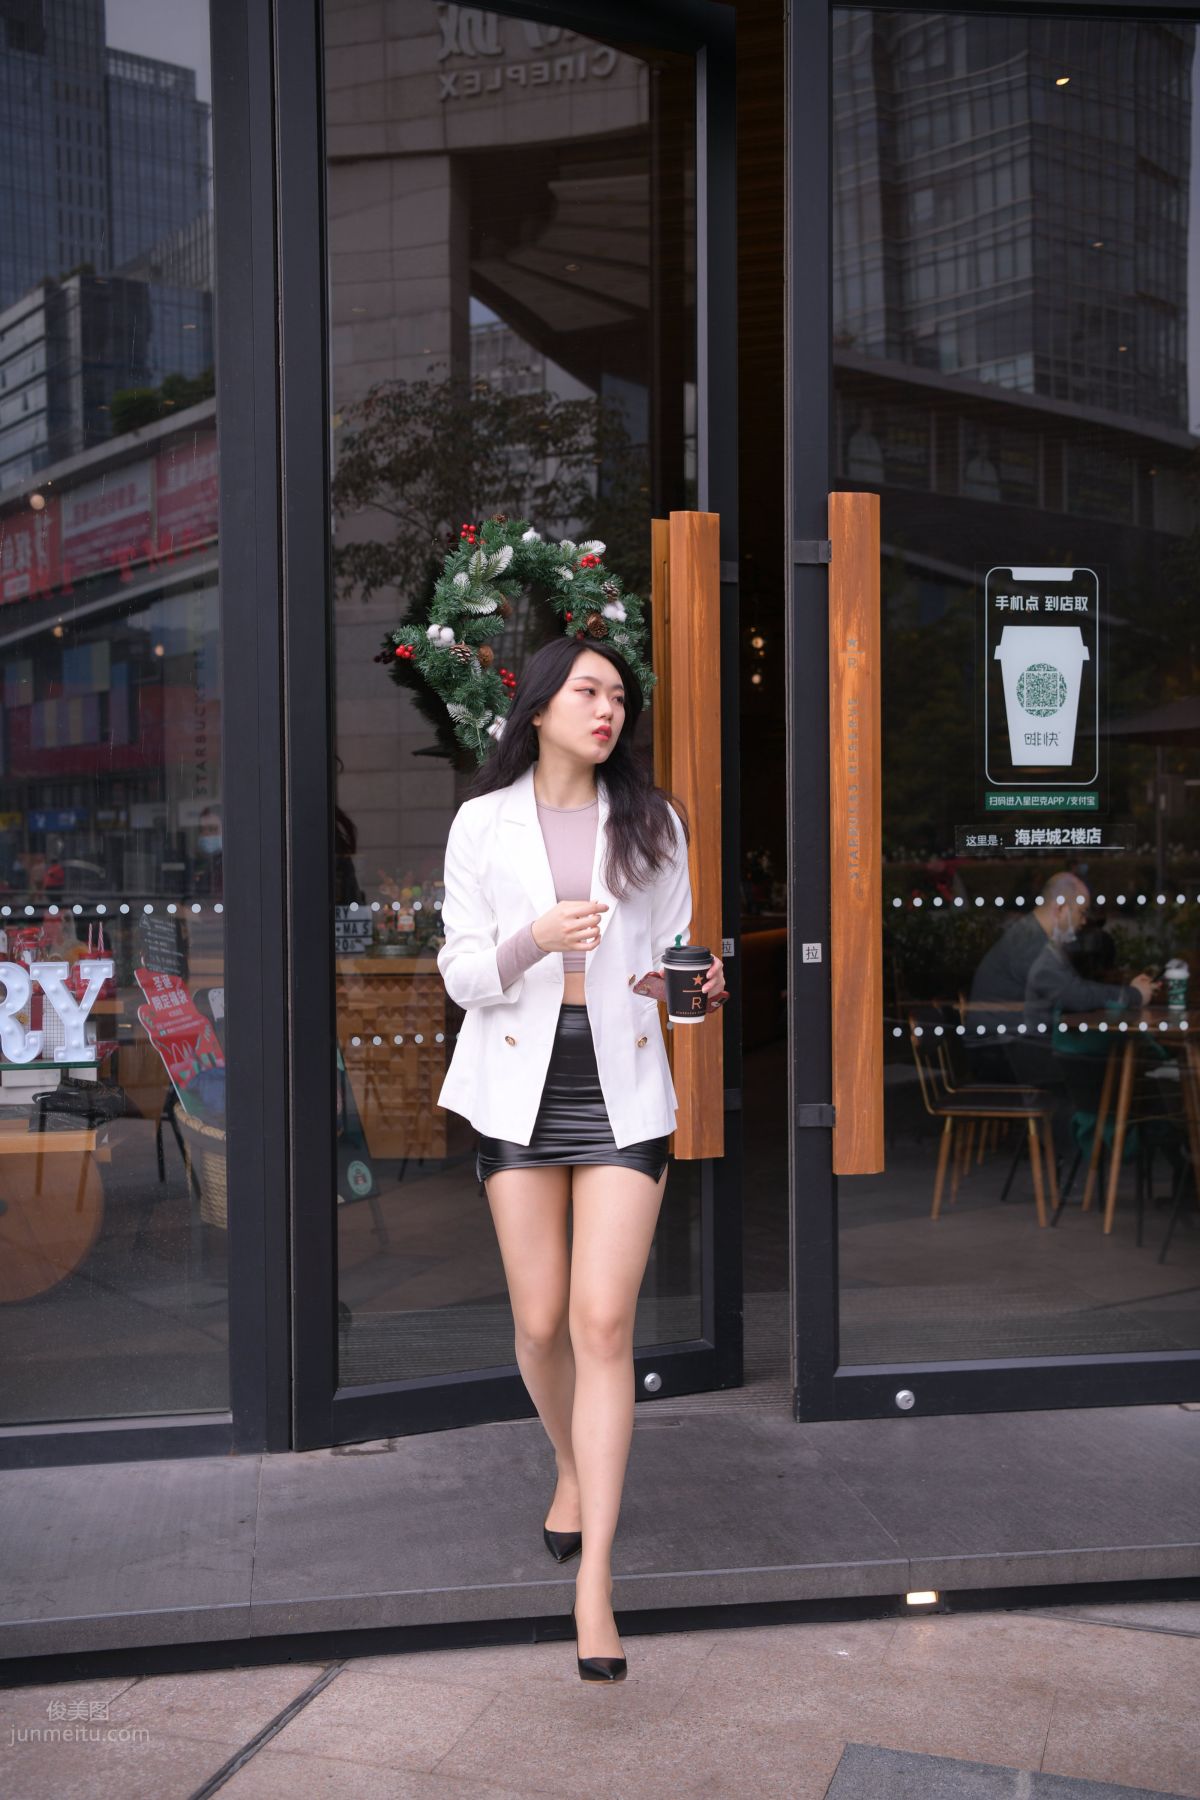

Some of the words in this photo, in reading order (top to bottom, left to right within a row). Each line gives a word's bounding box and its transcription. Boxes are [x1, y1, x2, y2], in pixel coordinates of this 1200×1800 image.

[995, 595, 1040, 612] 手机点
[1044, 595, 1089, 612] 到店取
[1014, 827, 1103, 847] 海岸城2楼店
[804, 945, 821, 961] 拉
[691, 996, 703, 1010] R
